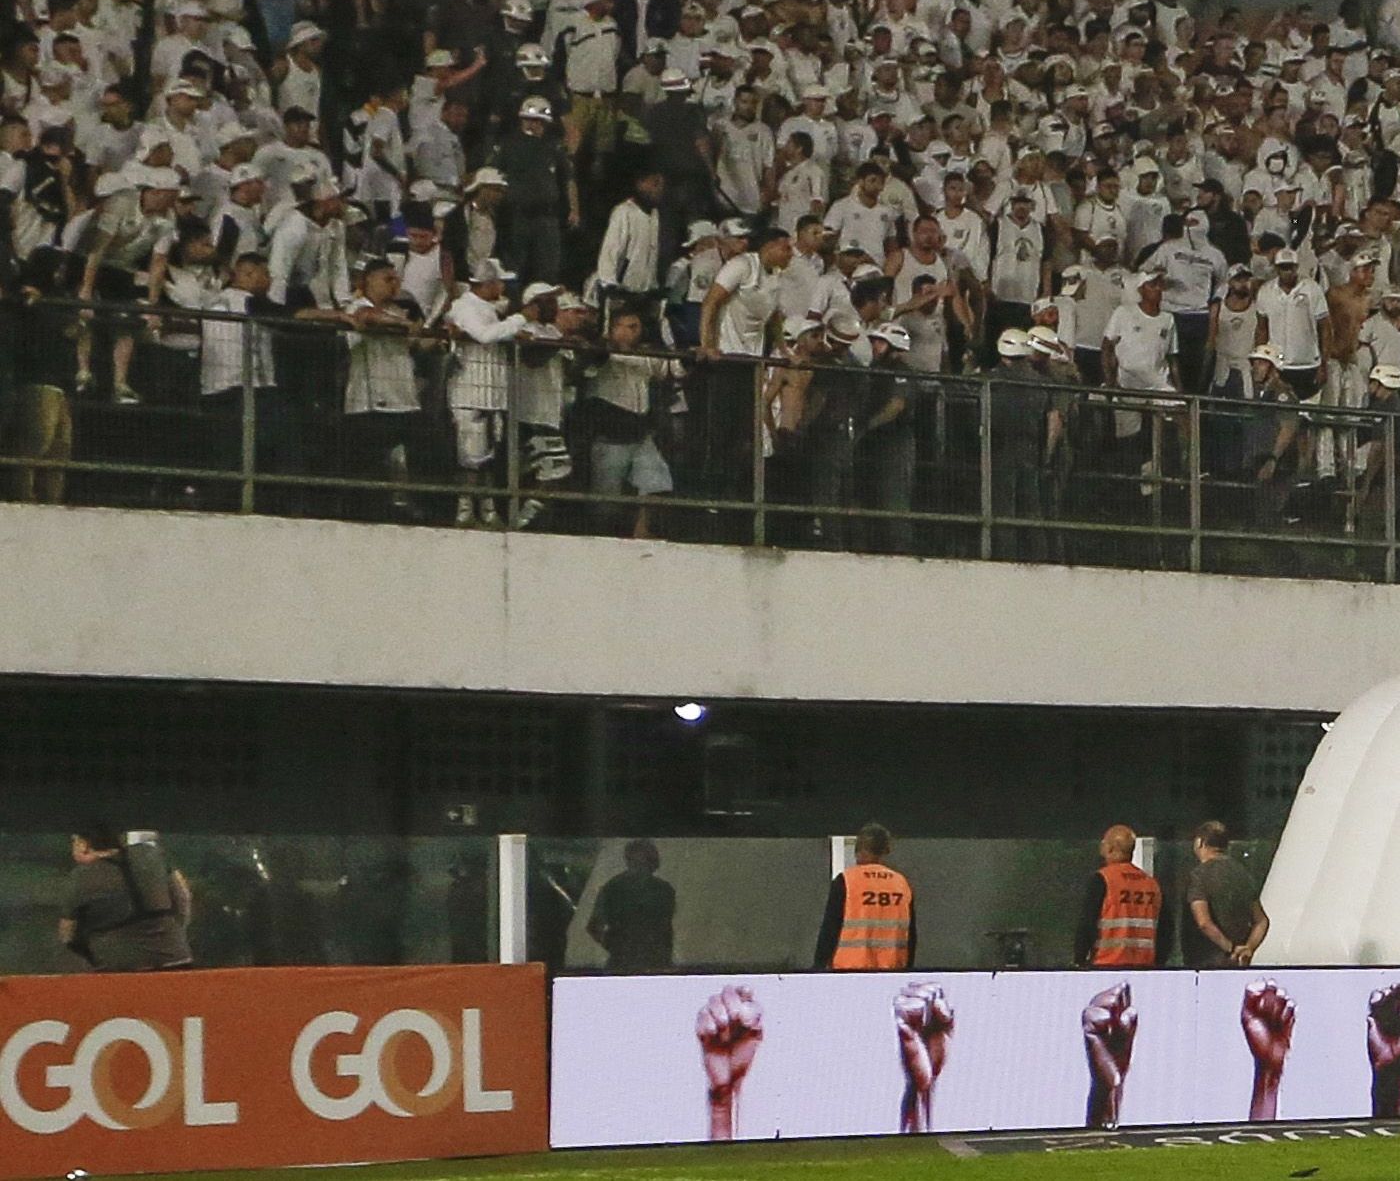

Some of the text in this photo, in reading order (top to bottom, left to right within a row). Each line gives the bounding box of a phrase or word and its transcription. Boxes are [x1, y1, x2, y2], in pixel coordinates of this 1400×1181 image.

[862, 890, 904, 907] 287
[1120, 890, 1156, 905] 227
[0, 1016, 239, 1134] GOL
[290, 1007, 514, 1120] GOL
